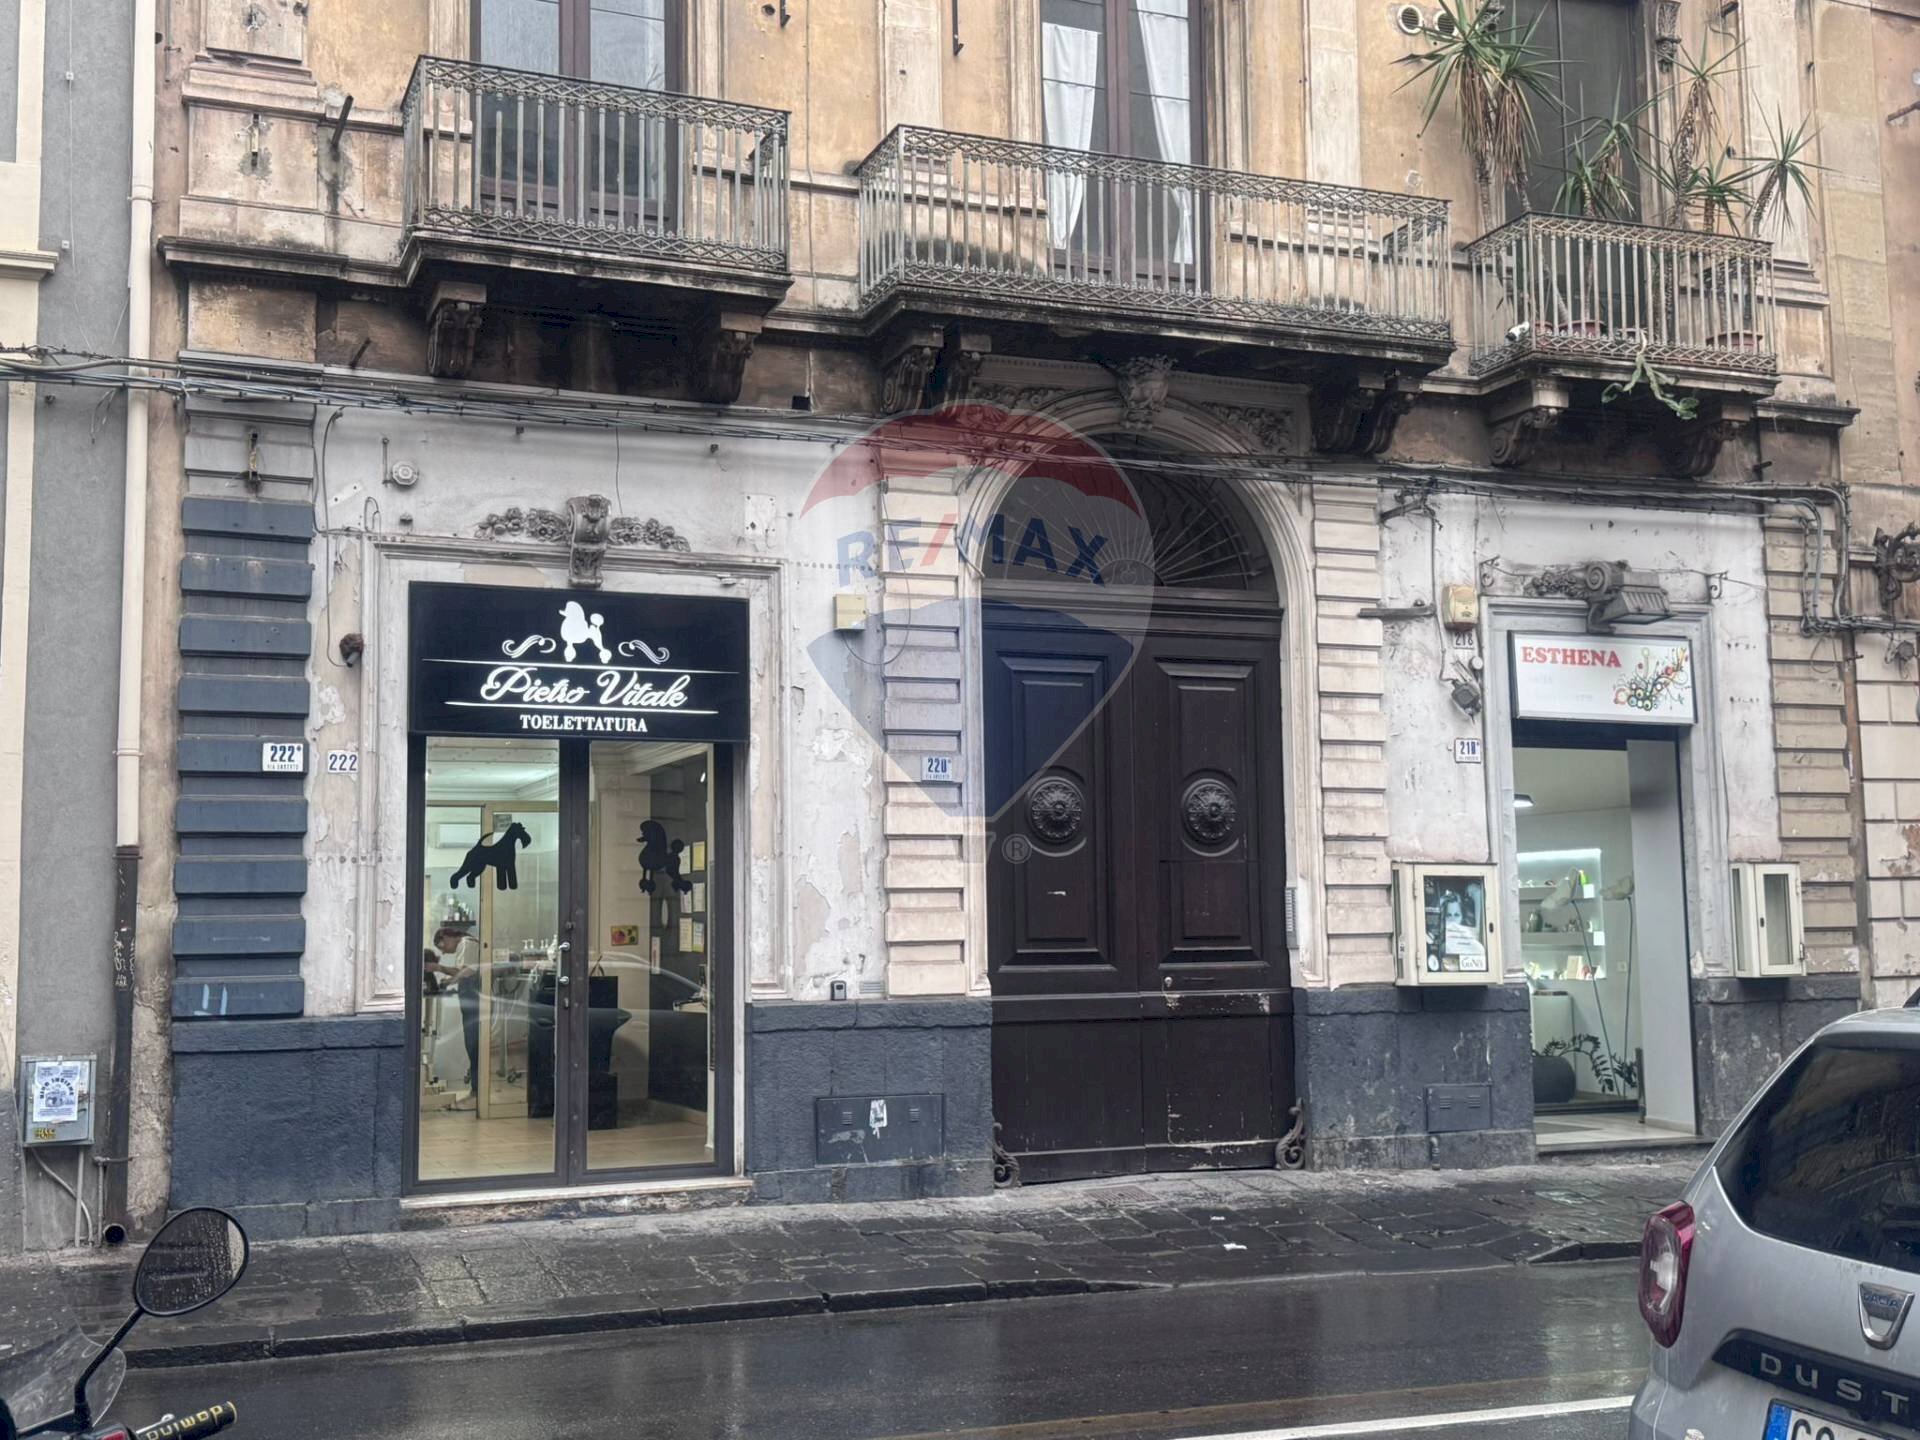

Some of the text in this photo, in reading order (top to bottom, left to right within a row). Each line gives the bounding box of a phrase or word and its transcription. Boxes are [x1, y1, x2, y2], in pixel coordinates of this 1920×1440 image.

[1520, 646, 1622, 669] ESTHENA
[480, 666, 691, 708] Pietro Vitale
[519, 714, 648, 733] TOELETTATURA
[329, 753, 358, 772] 222
